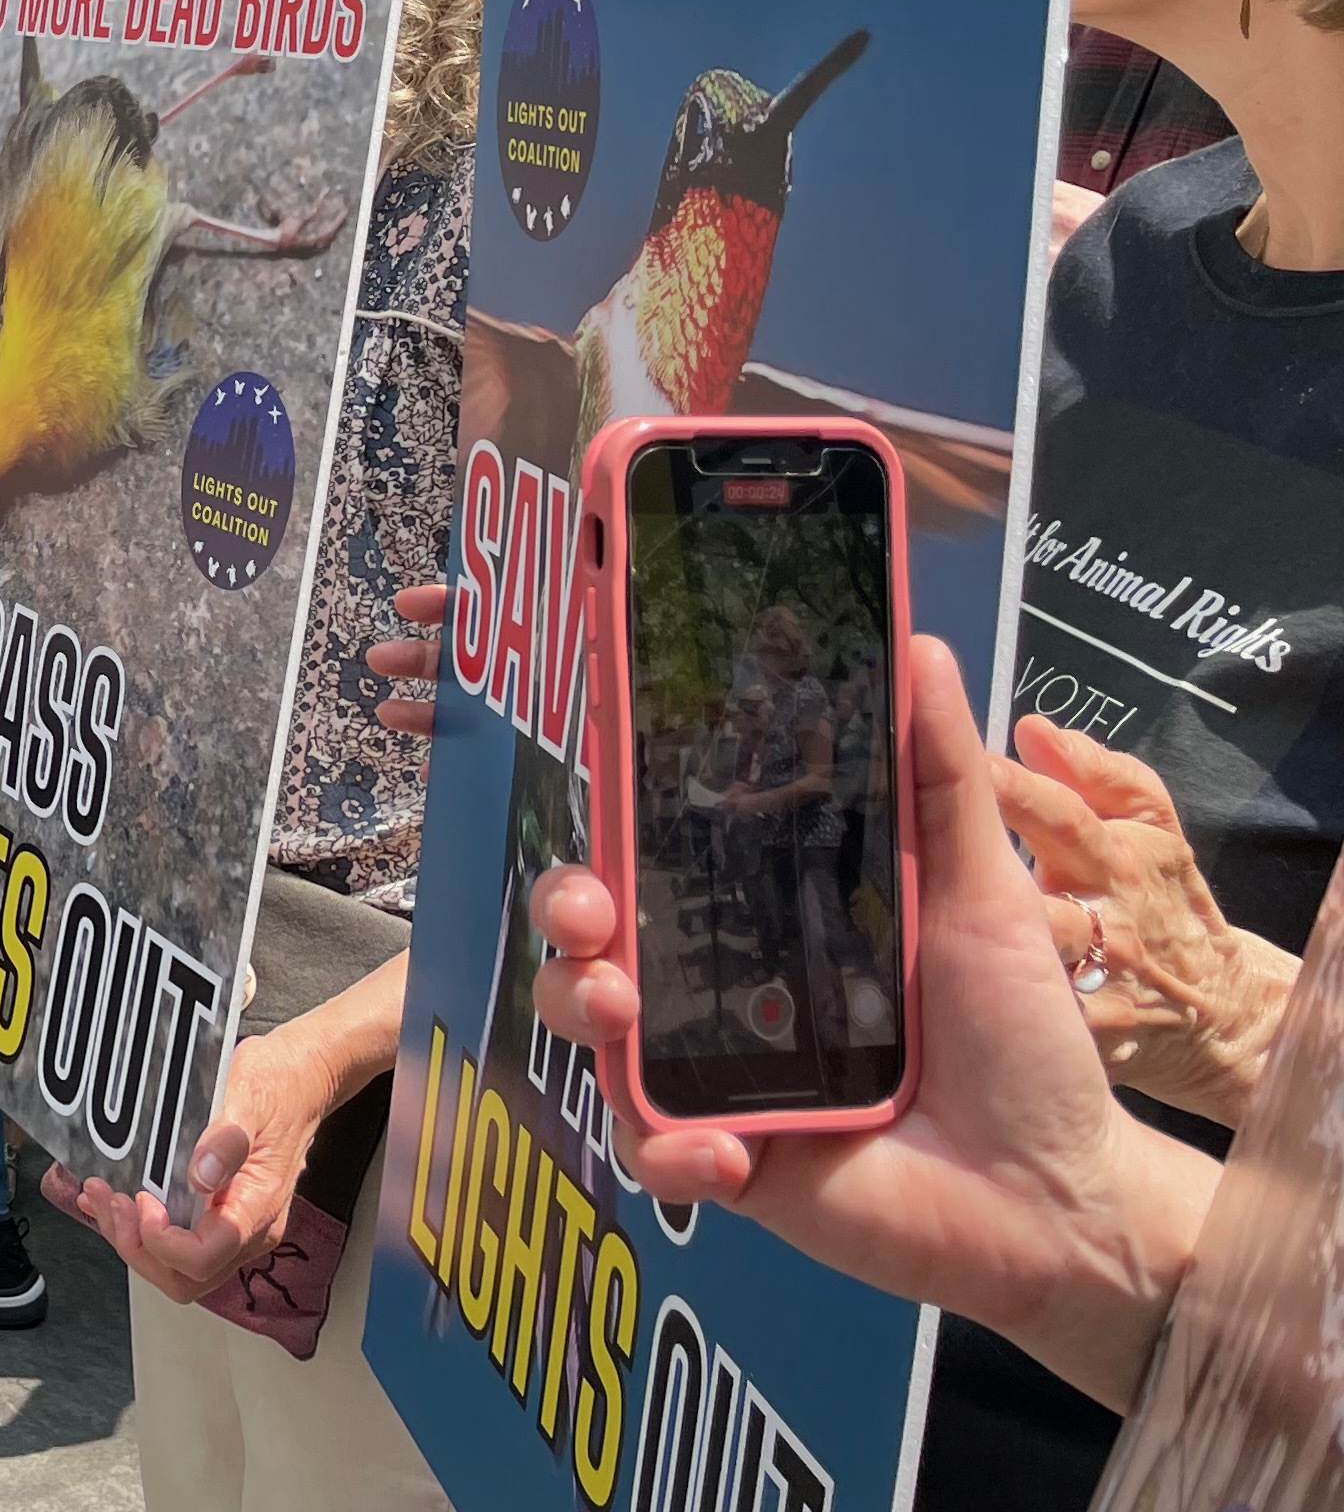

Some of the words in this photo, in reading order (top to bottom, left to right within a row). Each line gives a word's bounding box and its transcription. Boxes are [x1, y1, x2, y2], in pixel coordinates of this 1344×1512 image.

[507, 100, 554, 130] LIGHTS
[558, 108, 587, 134] OUT
[508, 138, 581, 173] COALITION
[192, 502, 269, 547] COALITION
[193, 473, 243, 506] LIGHTS
[247, 493, 278, 518] OUT
[453, 441, 590, 783] SAV
[1054, 536, 1193, 620] Animal
[1170, 589, 1291, 672] Rights
[39, 885, 222, 1205] OUT
[409, 1015, 640, 1510] LIGHTS
